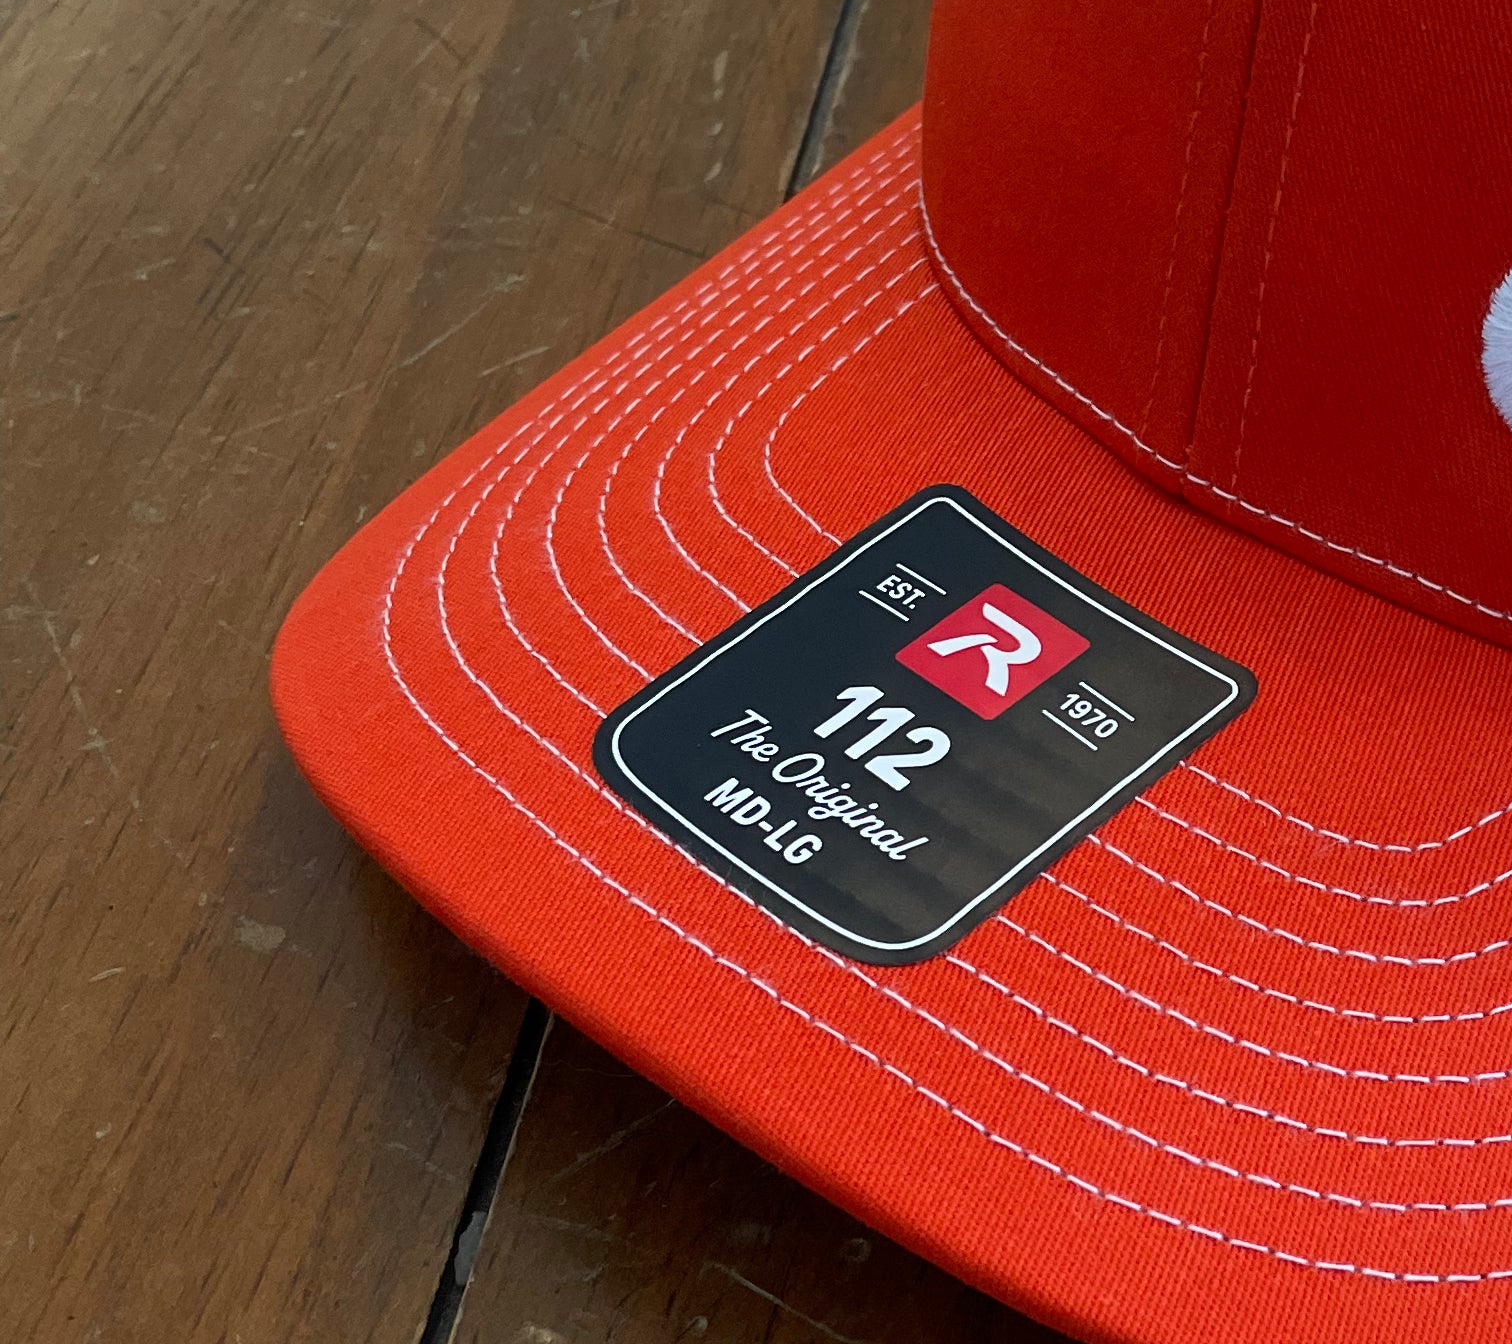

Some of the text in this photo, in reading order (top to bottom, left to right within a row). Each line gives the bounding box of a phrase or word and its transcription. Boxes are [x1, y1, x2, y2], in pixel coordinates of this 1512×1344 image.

[876, 574, 927, 610] EST.
[813, 686, 951, 792] 112
[1059, 693, 1119, 738] 1970
[703, 777, 823, 864] MD-LG
[710, 708, 930, 861] The Original
